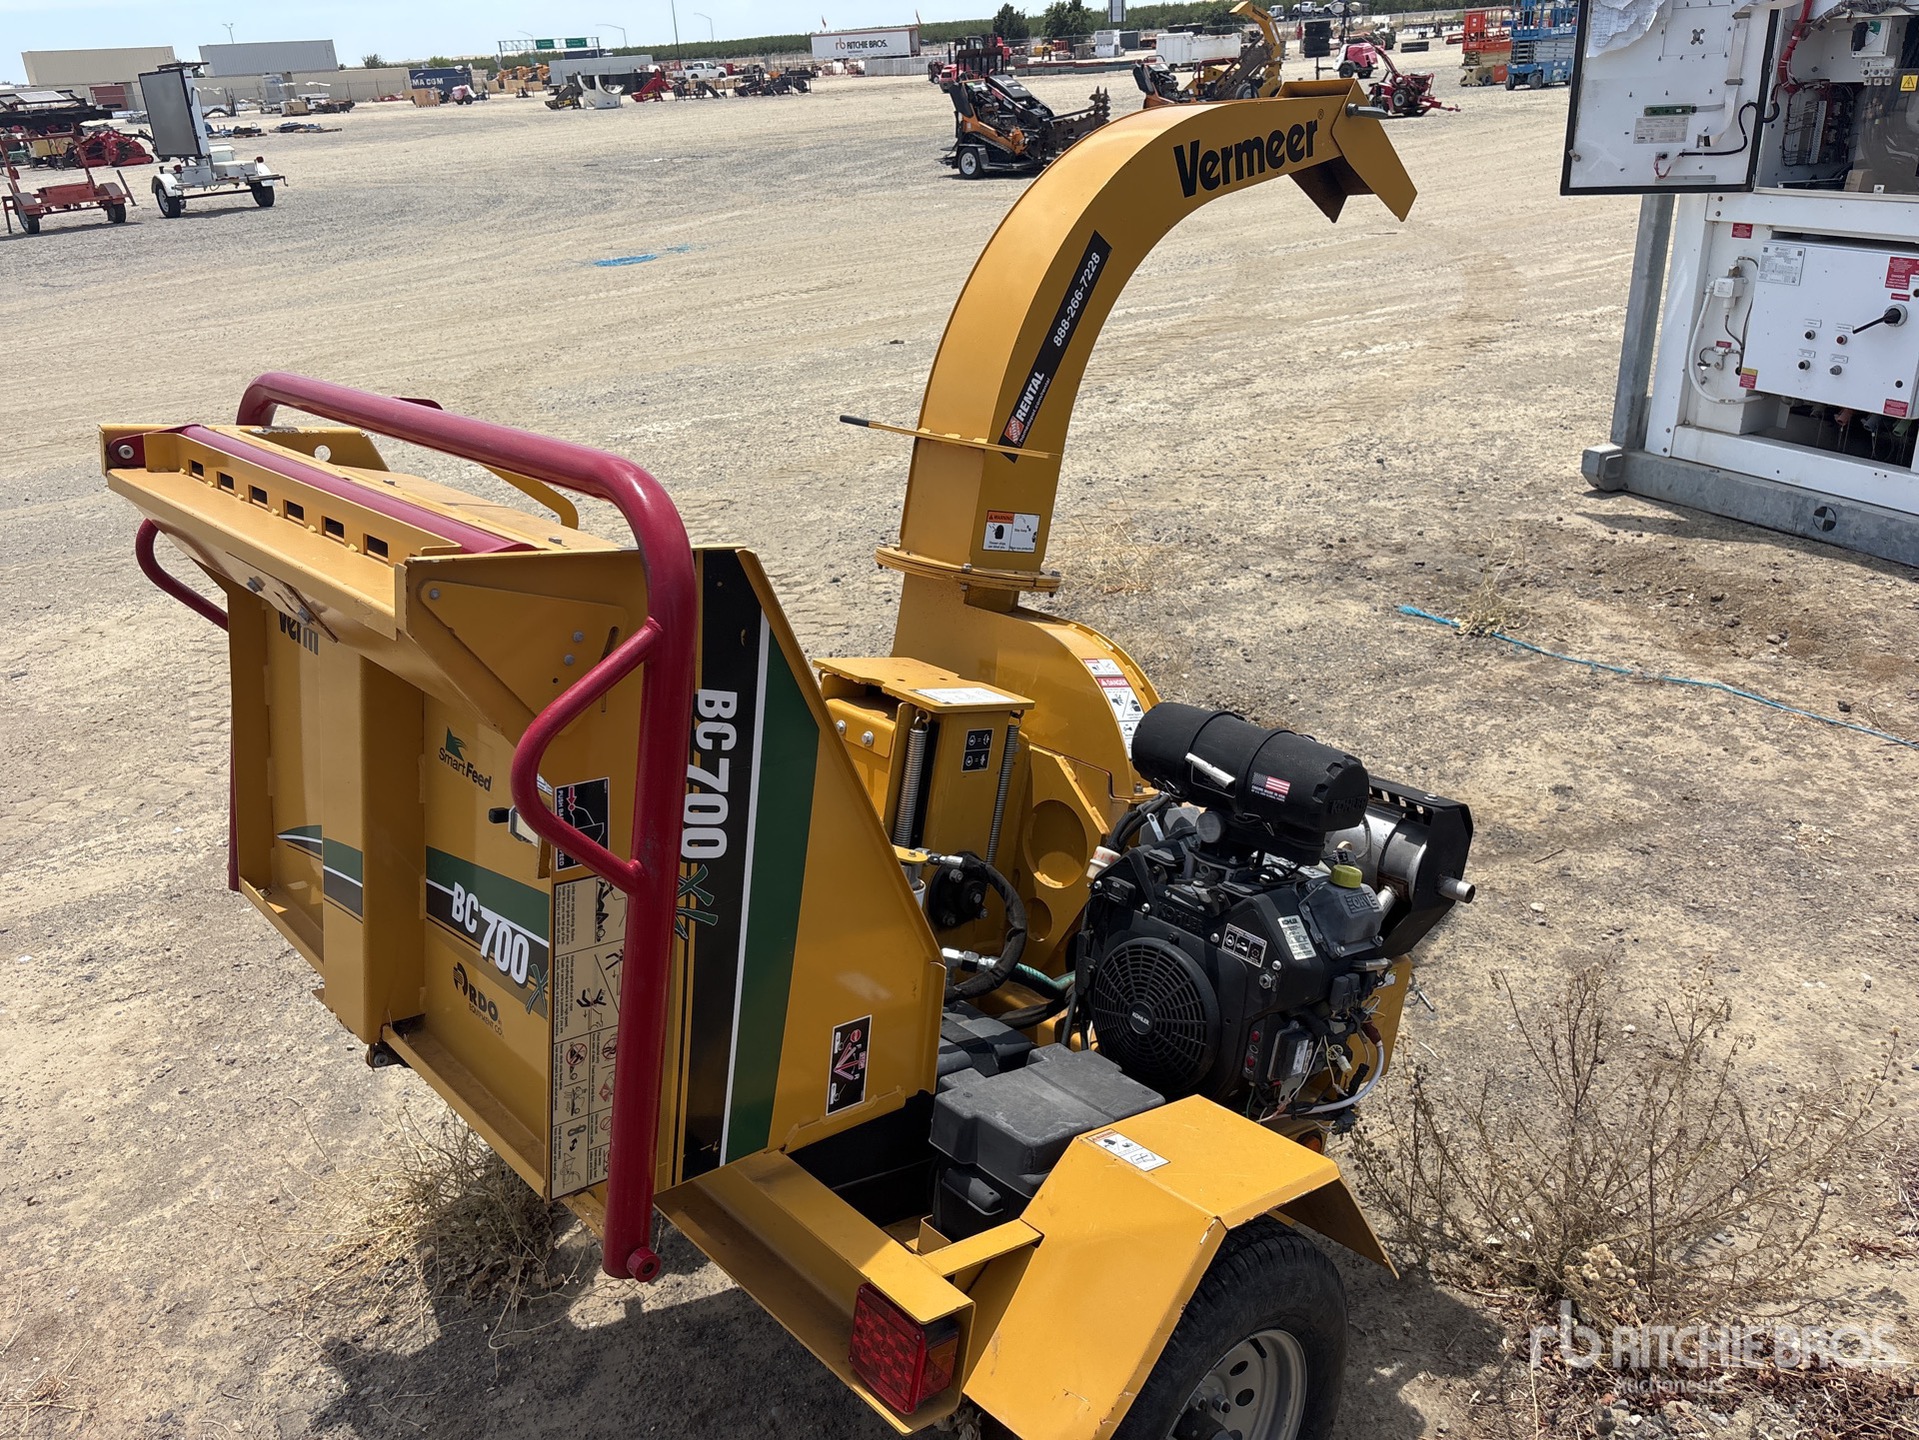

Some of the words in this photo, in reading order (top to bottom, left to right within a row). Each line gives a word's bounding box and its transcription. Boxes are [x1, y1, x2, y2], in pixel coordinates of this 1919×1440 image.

[846, 40, 868, 50] RITCHIE
[868, 39, 888, 48] BROS.
[1173, 119, 1318, 198] Vermeer
[1053, 252, 1101, 347] 888-266-7228
[1016, 371, 1045, 421] RENTAL
[696, 689, 739, 752] BC
[682, 757, 730, 860] 700
[452, 882, 479, 934] BC
[480, 905, 530, 984] 700
[1352, 894, 1371, 908] OHV
